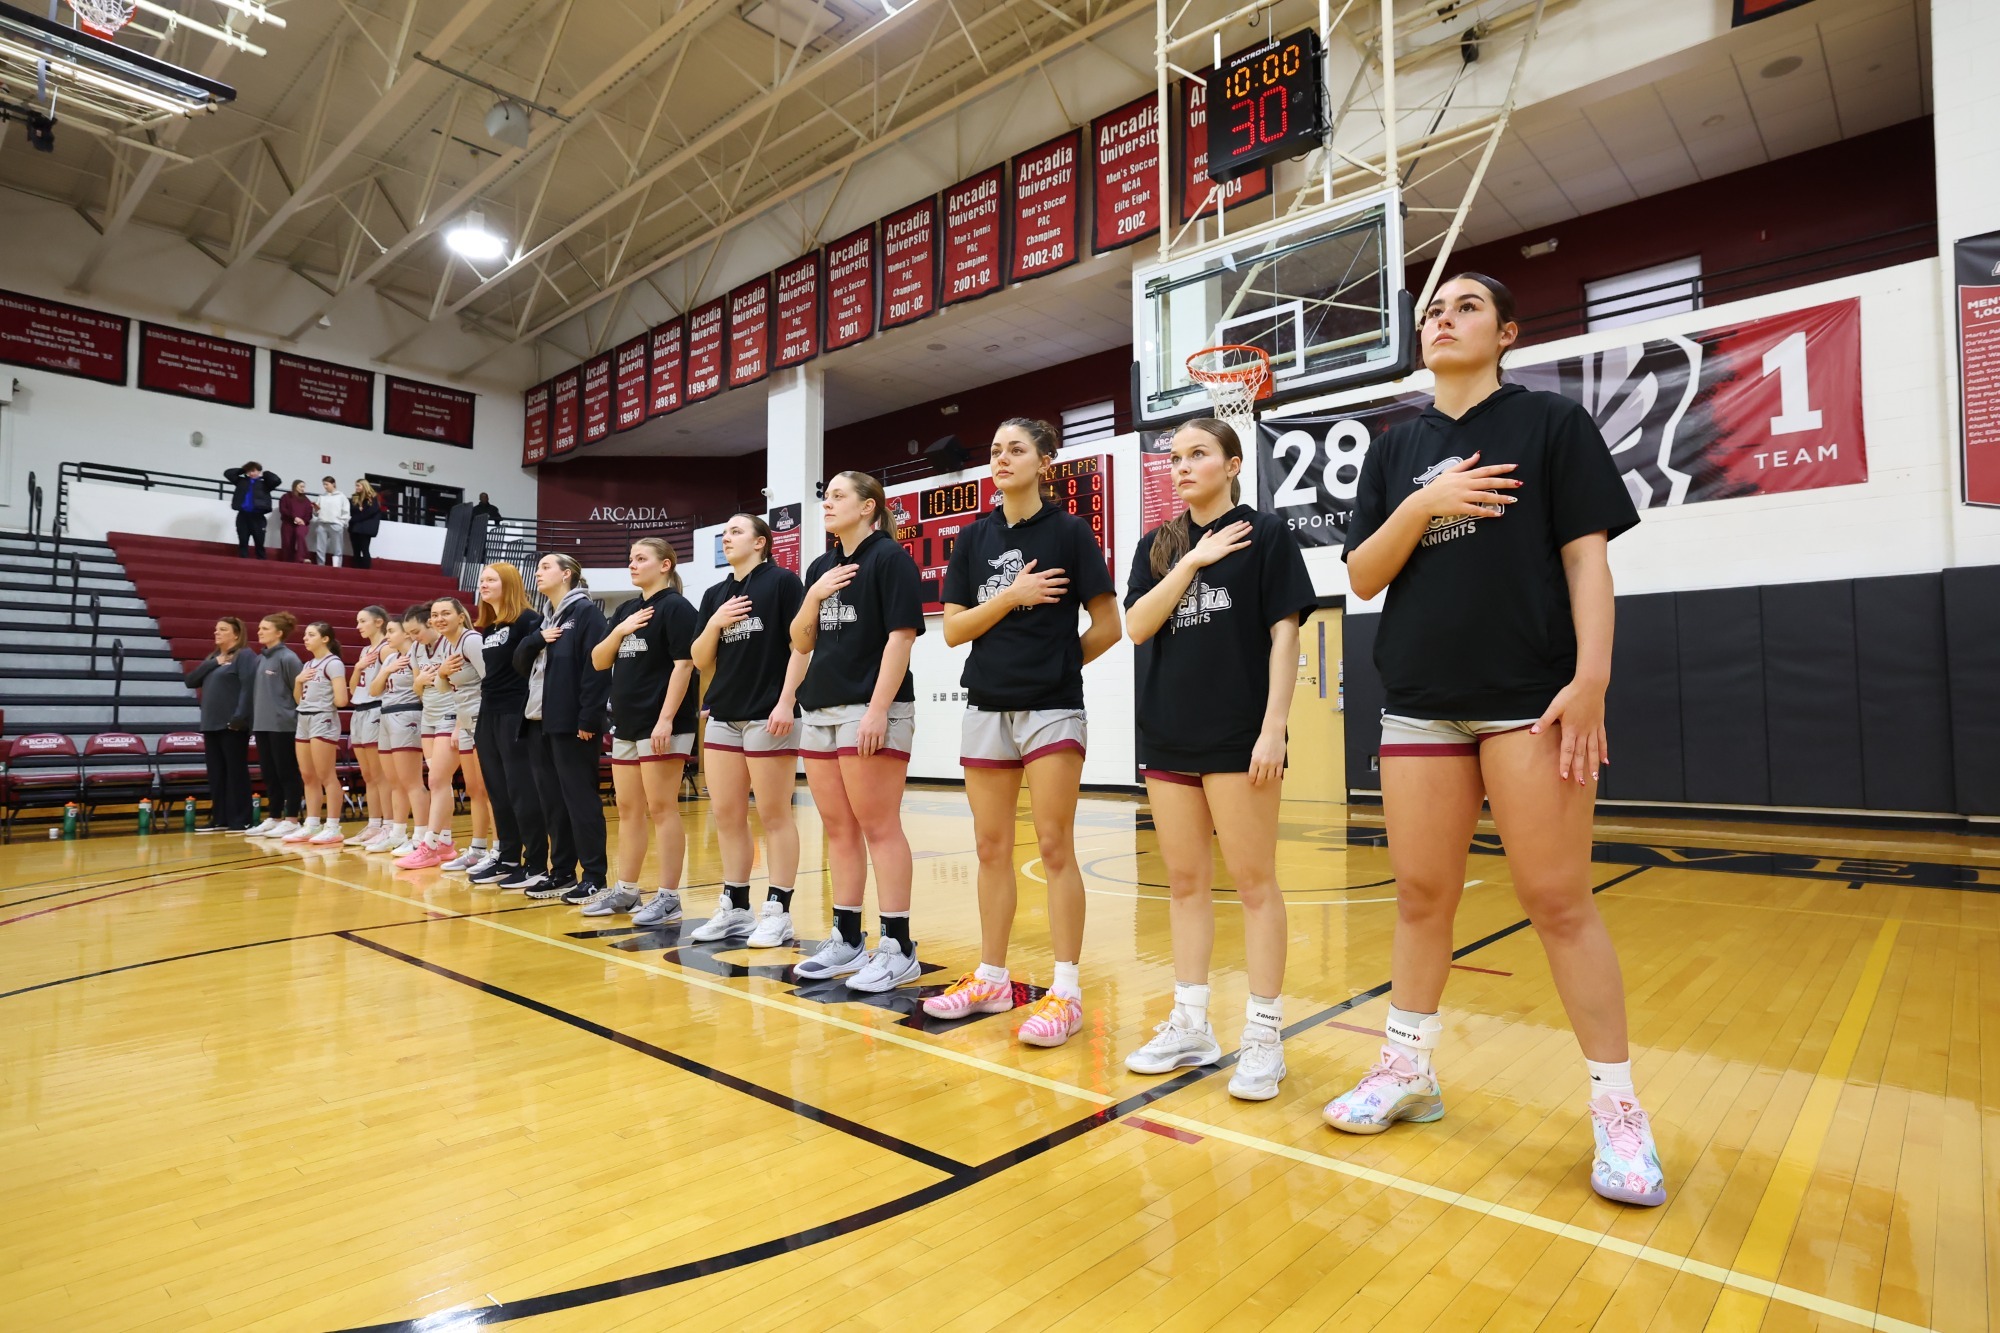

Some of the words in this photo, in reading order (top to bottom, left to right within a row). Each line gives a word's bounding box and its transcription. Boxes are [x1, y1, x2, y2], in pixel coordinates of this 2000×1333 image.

[1230, 40, 1280, 68] DAKTRONICS
[1226, 44, 1300, 99] 10:00
[1100, 105, 1160, 147] Arcadia
[1232, 85, 1287, 156] 30
[1019, 147, 1073, 183] Arcadia
[1106, 168, 1128, 184] Men's
[1130, 157, 1158, 174] Soccer
[1018, 168, 1072, 200] University
[1122, 176, 1141, 194] NCAA
[949, 180, 997, 214] Arcadia
[1022, 204, 1042, 219] Men's
[1043, 194, 1067, 210] Soccer
[1114, 198, 1130, 214] Elite
[1131, 190, 1150, 206] Eight
[948, 198, 997, 228] University
[1037, 214, 1050, 228] PAC
[1117, 210, 1146, 235] 2002
[886, 210, 930, 242] Arcadia
[954, 232, 971, 246] Men's
[973, 223, 991, 238] Tennis
[1026, 227, 1061, 247] Champions
[830, 237, 869, 268] Arcadia
[886, 228, 930, 256] University
[966, 242, 978, 254] PAC
[888, 258, 910, 274] Women's
[910, 251, 928, 264] Tennis
[956, 254, 988, 272] Champions
[1022, 243, 1064, 269] 2002-03
[779, 263, 815, 290] Arcadia
[830, 255, 869, 282] University
[902, 270, 912, 281] PAC
[778, 280, 816, 304] University
[848, 278, 867, 292] Soccer
[892, 280, 922, 298] Champions
[952, 268, 990, 294] 2001-02
[733, 286, 766, 313] Arcadia
[796, 301, 812, 314] Soccer
[842, 294, 856, 306] NCAA
[854, 304, 862, 314] 16
[890, 295, 924, 319] 2001-02
[40, 306, 58, 318] Hall
[72, 315, 96, 326] Fame
[98, 320, 122, 332] 2013
[692, 306, 721, 330] Arcadia
[732, 302, 766, 326] University
[654, 326, 681, 348] Arcadia
[691, 322, 721, 342] University
[840, 320, 858, 340] 2001
[180, 337, 196, 346] Hall
[208, 343, 228, 354] Fame
[618, 344, 644, 366] Arcadia
[654, 341, 680, 360] University
[782, 340, 810, 360] 2001-02
[1762, 331, 1823, 436] 1
[412, 462, 424, 471] EXIT
[1272, 420, 1371, 508] 28
[1754, 444, 1839, 470] TEAM
[1045, 466, 1056, 480] LY
[1062, 464, 1074, 477] FL
[1078, 458, 1097, 474] PTS
[1068, 479, 1076, 495] 0
[1092, 474, 1100, 490] 0
[929, 484, 976, 515] 10:00
[1068, 498, 1076, 515] 0
[1092, 494, 1100, 510] 0
[588, 506, 668, 522] ARCADIA
[1092, 514, 1100, 531] 0
[938, 525, 960, 536] PERIOD
[1421, 522, 1476, 548] KNIGHTS
[922, 570, 936, 580] PLYR
[20, 737, 66, 746] ARCADIA
[94, 736, 138, 744] ARCADIA
